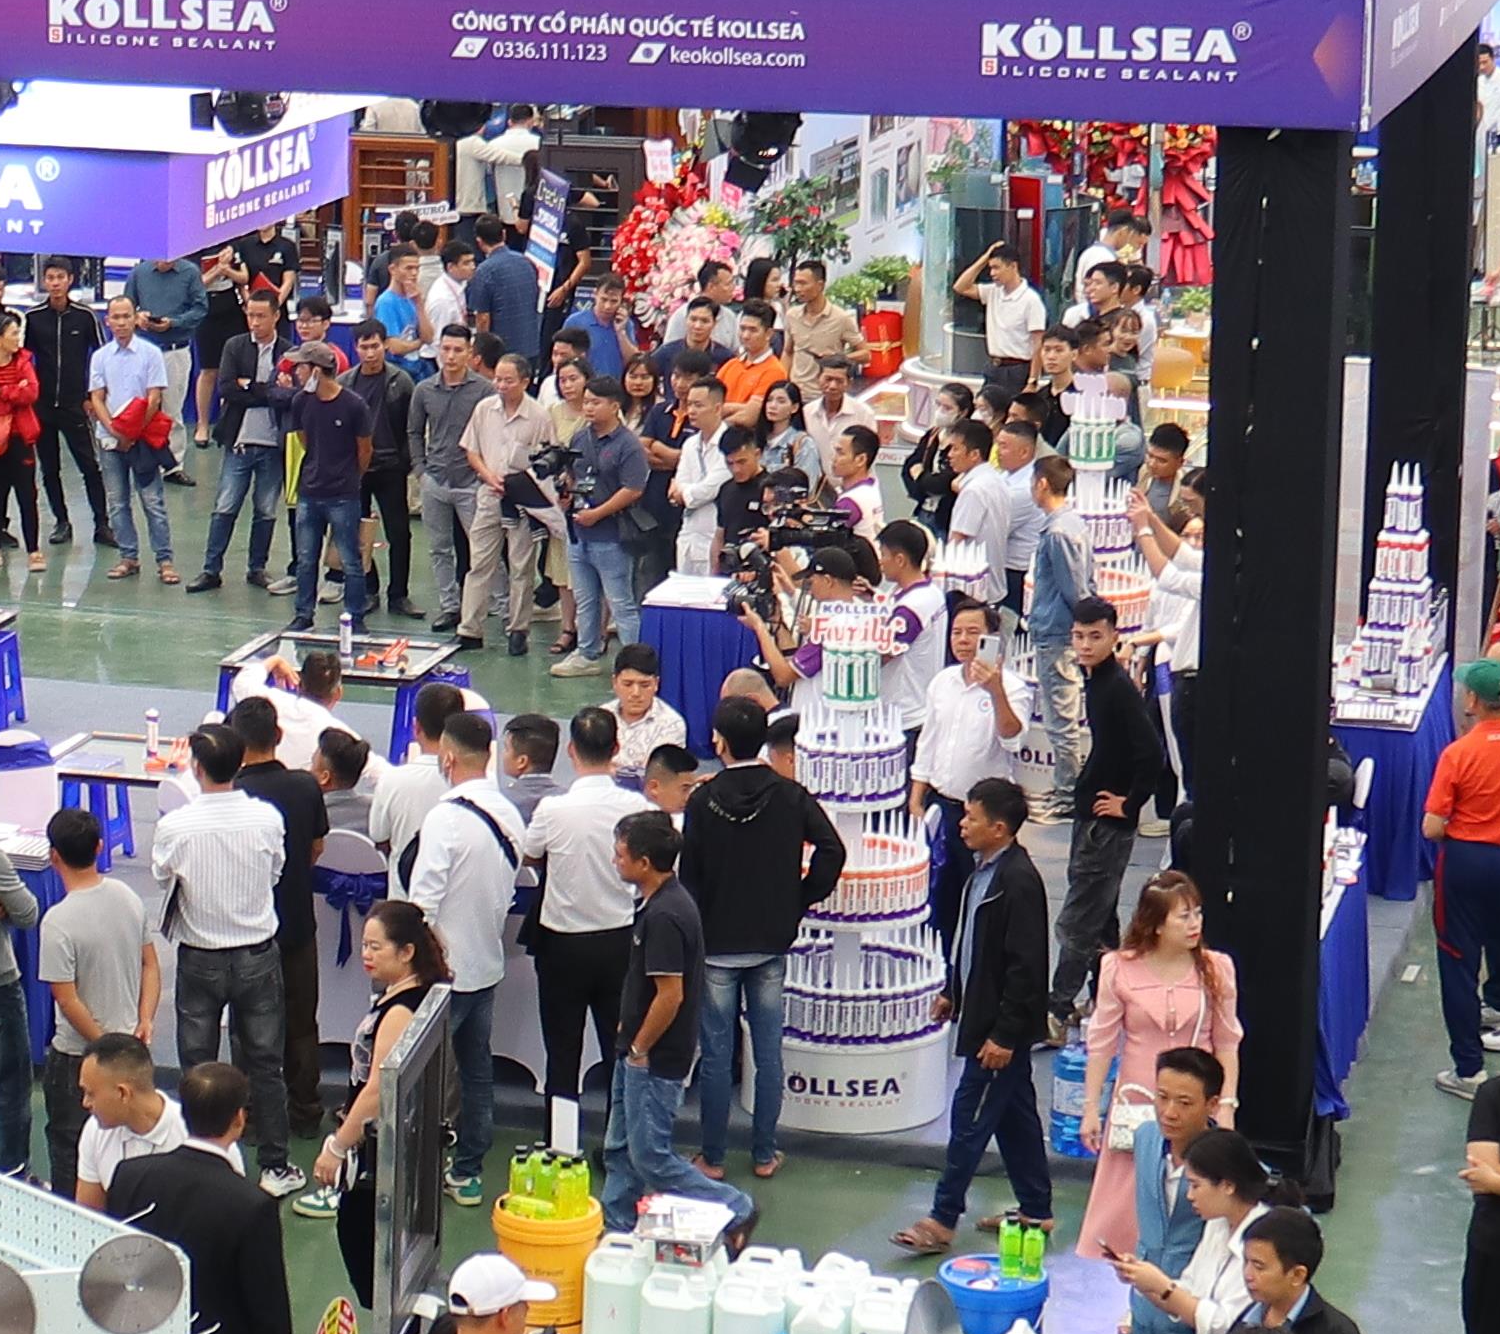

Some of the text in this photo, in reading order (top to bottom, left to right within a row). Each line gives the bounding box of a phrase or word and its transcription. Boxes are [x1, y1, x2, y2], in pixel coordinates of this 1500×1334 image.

[48, 26, 277, 53] SILICONE SEALANT
[450, 9, 508, 33] CÔNG
[509, 14, 535, 34] TY
[628, 10, 689, 40] QUỐC
[690, 11, 715, 39] TẾ
[717, 19, 805, 42] KOLLSEA
[980, 17, 1238, 64] KÖLLSEA
[492, 41, 806, 69] 0336.111.123 keokollsea.com
[980, 56, 1239, 83] SILICONE SEALANT
[204, 132, 312, 205] KÖLLSEA
[786, 1071, 901, 1098] ÖLLSEA
